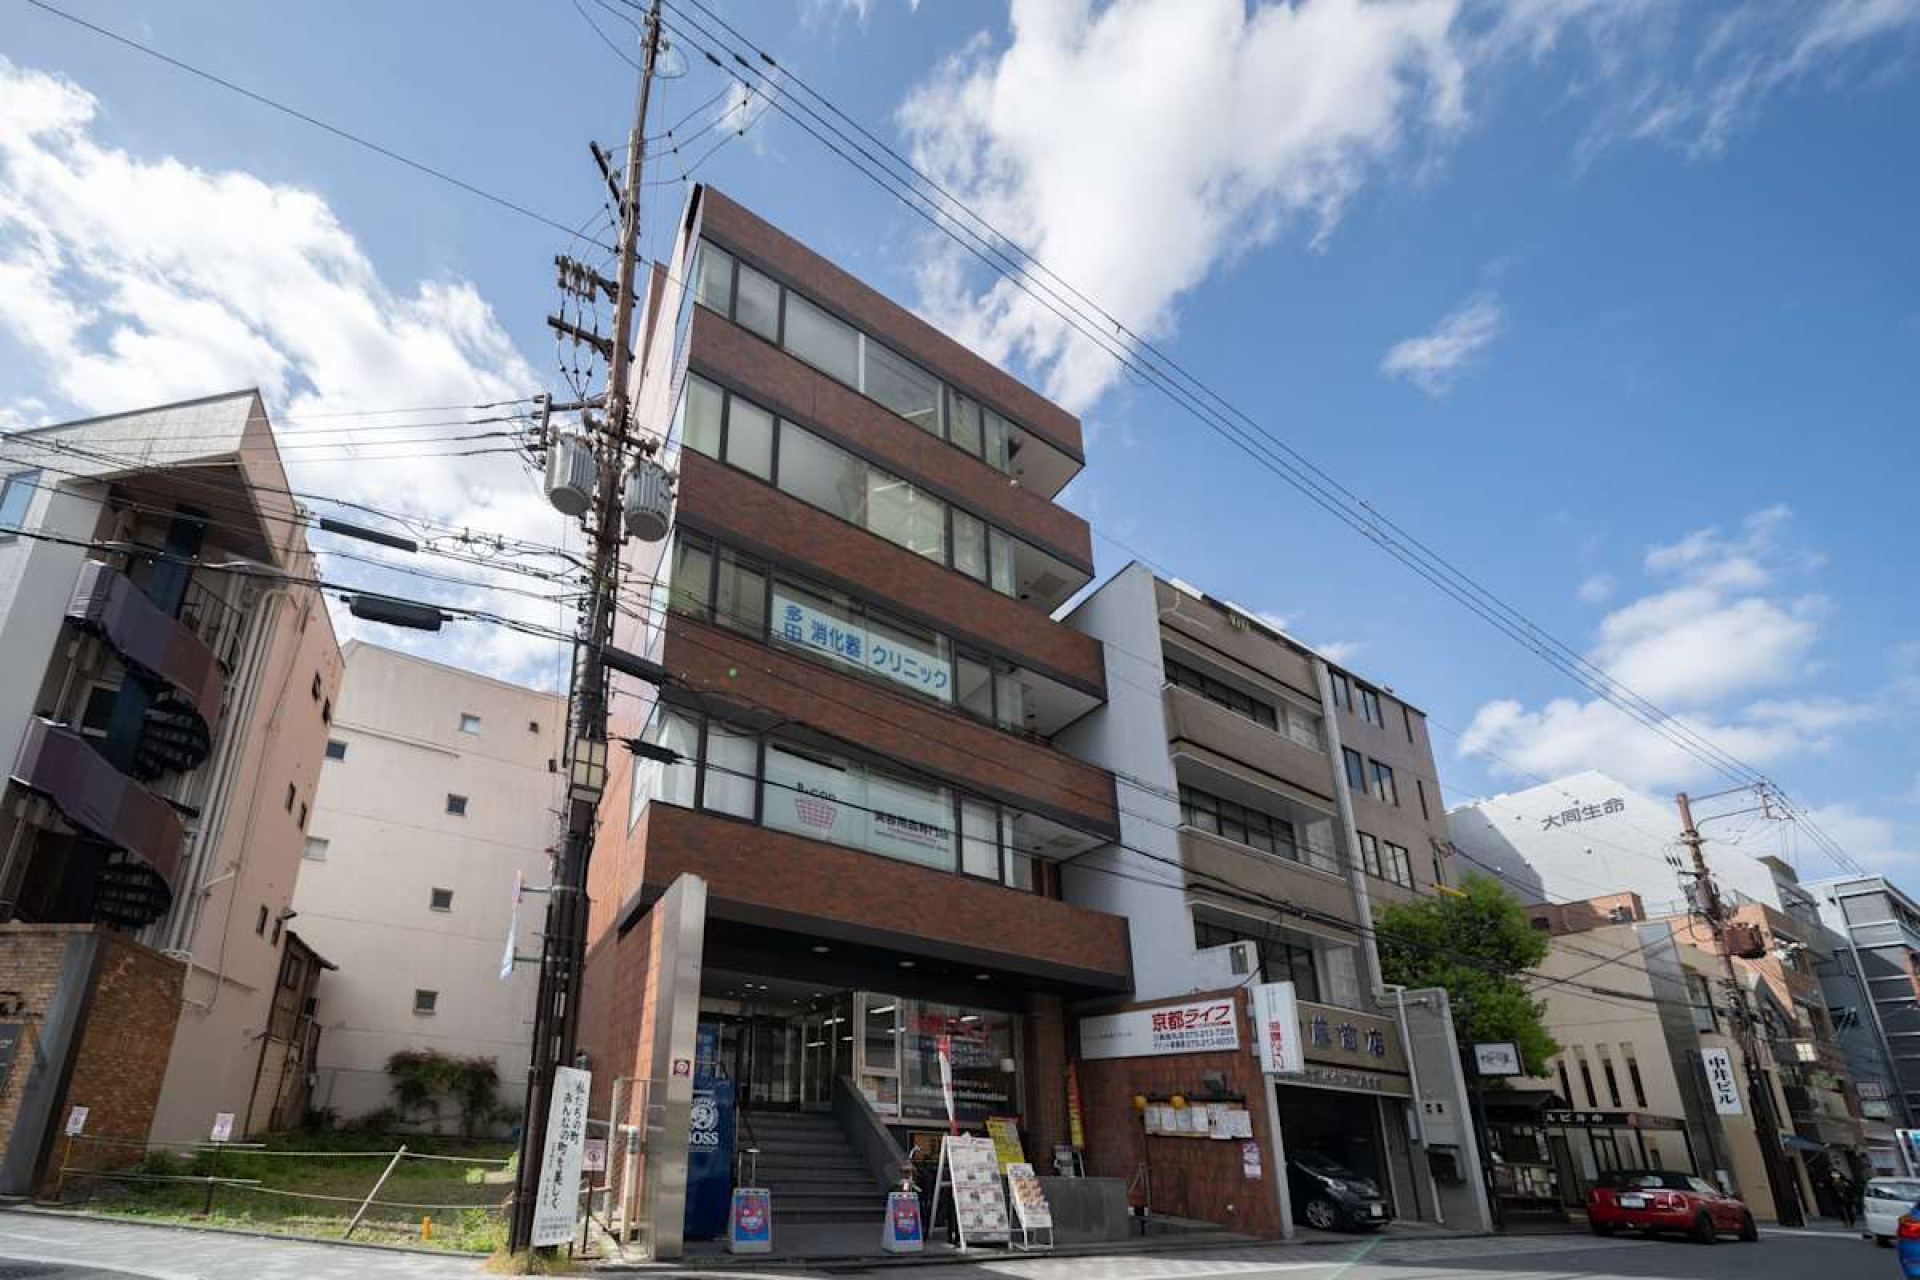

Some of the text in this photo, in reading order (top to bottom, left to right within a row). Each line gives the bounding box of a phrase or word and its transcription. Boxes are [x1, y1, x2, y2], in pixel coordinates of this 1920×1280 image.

[783, 604, 948, 689] 多田 消化器 クリニック
[1541, 797, 1625, 830] 大同生命
[1152, 1005, 1232, 1032] 京都ライフ
[1708, 1055, 1736, 1105] 中井ビル
[690, 1130, 719, 1145] OSS
